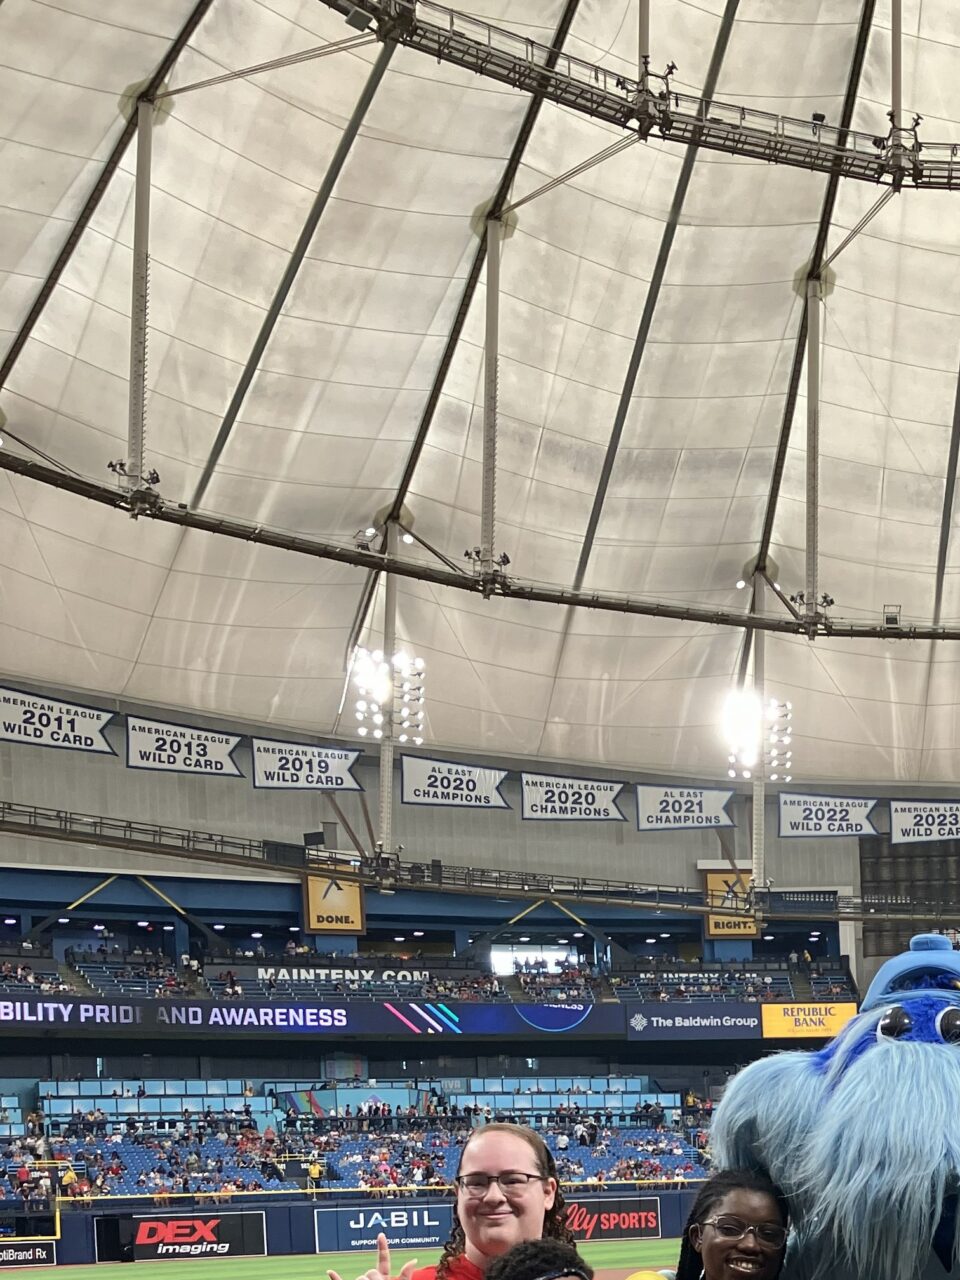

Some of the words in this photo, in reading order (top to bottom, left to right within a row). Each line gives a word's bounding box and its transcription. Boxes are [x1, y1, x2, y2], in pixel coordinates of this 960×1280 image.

[59, 707, 102, 720] LEAGUE
[22, 710, 76, 732] 2011
[3, 722, 43, 738] WILD
[50, 731, 94, 747] CARD
[131, 725, 186, 739] AMERICAN
[190, 732, 230, 745] LEAGUE
[155, 737, 208, 757] 2013
[256, 746, 308, 757] AMERICAN
[311, 752, 350, 760] LEAGUE
[139, 750, 177, 765] WILD
[183, 757, 224, 771] CARD
[278, 756, 329, 774] 2019
[264, 771, 300, 783] WILD
[305, 774, 344, 786] CARD
[431, 766, 443, 774] AL
[447, 768, 472, 777] EAST
[427, 774, 477, 792] 2020
[525, 780, 574, 790] AMERICAN
[578, 783, 615, 792] LEAGUE
[413, 788, 491, 804] CHAMPIONS
[544, 790, 596, 806] 2020
[530, 804, 610, 817] CHAMPIONS
[659, 800, 704, 813] 2021
[783, 799, 832, 808] AMERICAN
[894, 806, 940, 814] AMERICAN
[646, 815, 721, 824] CHAMPIONS
[802, 808, 850, 822] 2022
[913, 813, 959, 827] 2023
[790, 821, 822, 831] WILD
[827, 822, 863, 833] CARD
[901, 828, 933, 837] WILD
[317, 915, 354, 924] DONE.
[713, 921, 751, 930] RIGHT.
[0, 1001, 73, 1022] BILITY
[157, 1006, 202, 1024] AND
[208, 1007, 347, 1026] AWARENESS
[782, 1006, 836, 1017] REPUBLIC
[651, 1017, 673, 1027] The
[675, 1016, 721, 1027] Baldwin
[722, 1016, 758, 1028] Group
[794, 1017, 826, 1027] BANK
[350, 1210, 439, 1228] JABIL
[600, 1212, 657, 1230] SPORTS
[135, 1219, 221, 1245] DEX
[401, 1236, 440, 1244] COMMUNITY
[35, 1248, 47, 1259] Rx
[157, 1241, 230, 1255] imaging
